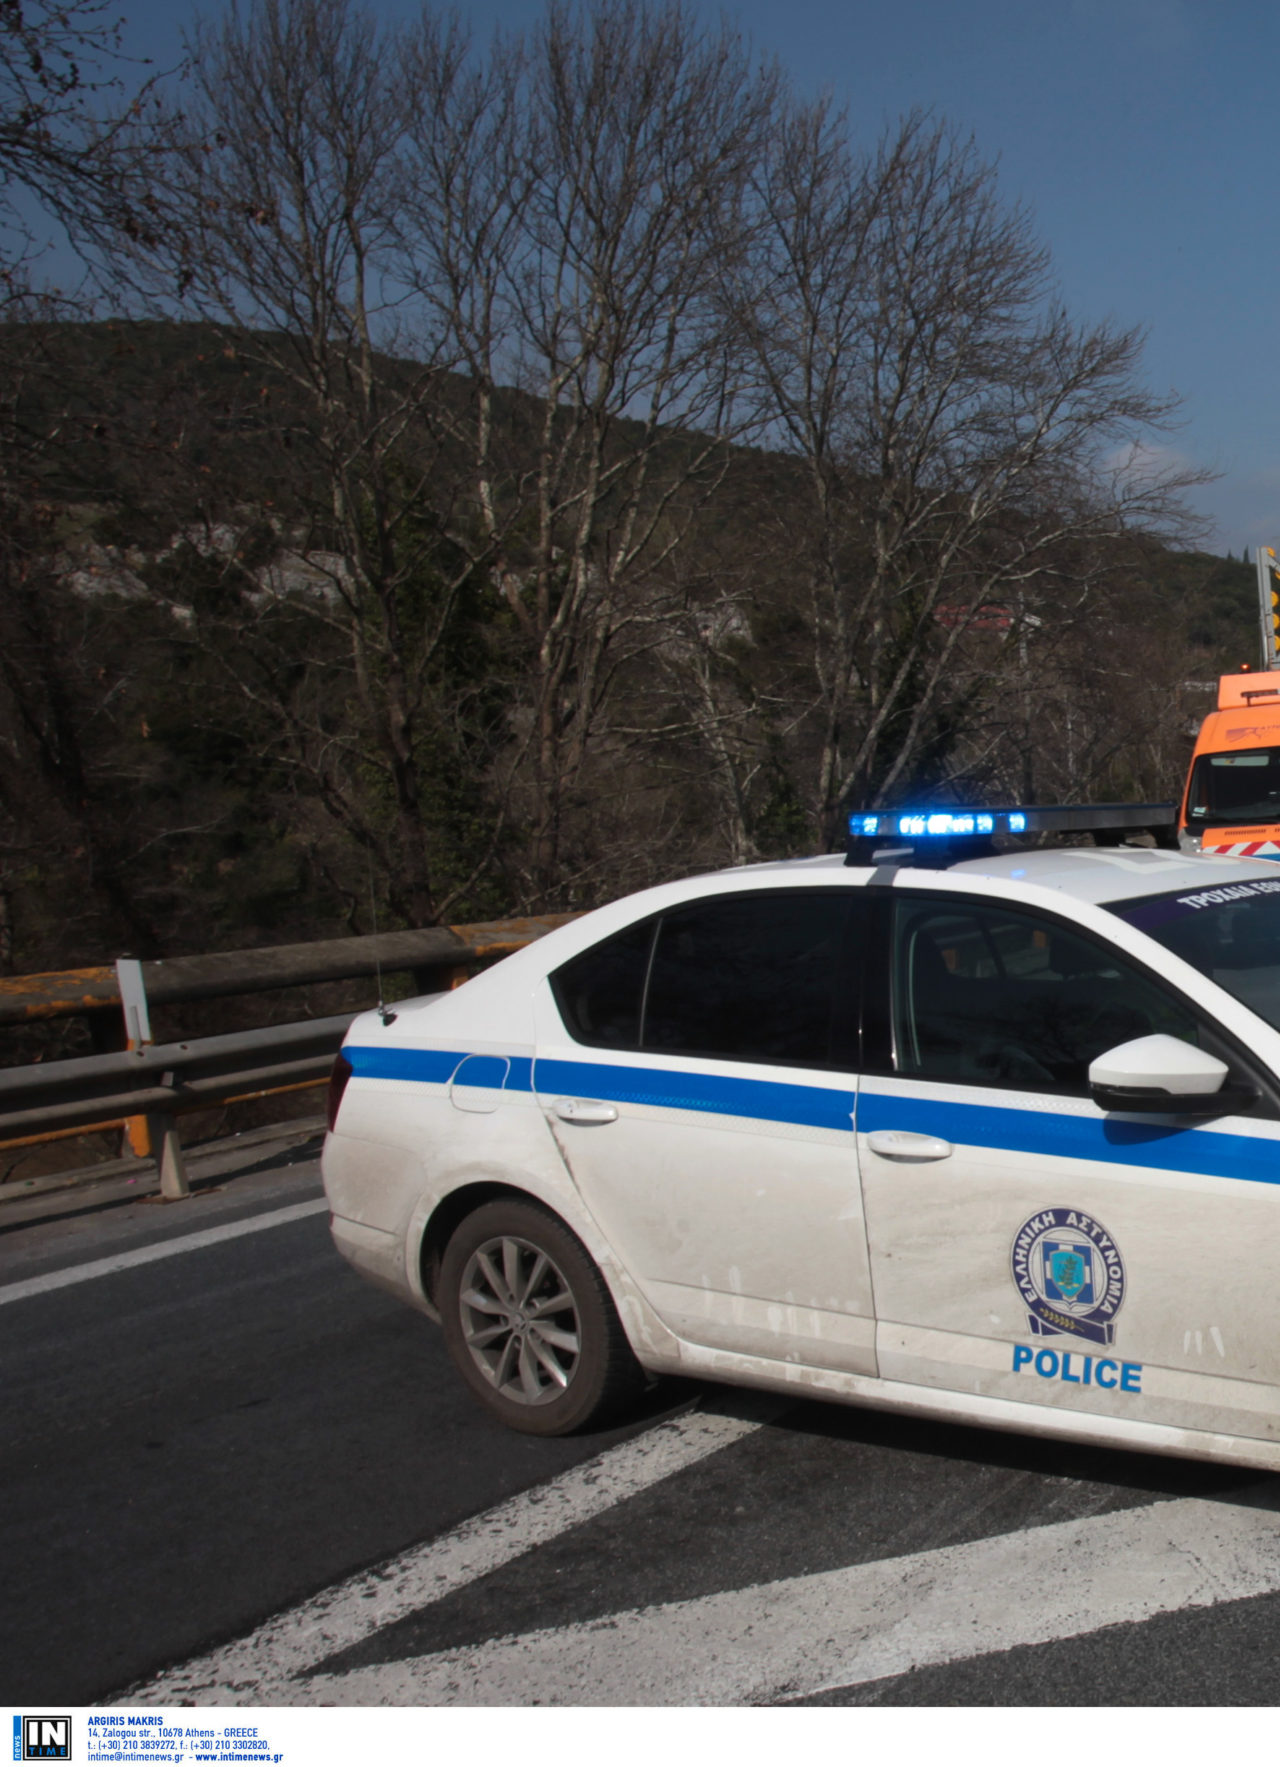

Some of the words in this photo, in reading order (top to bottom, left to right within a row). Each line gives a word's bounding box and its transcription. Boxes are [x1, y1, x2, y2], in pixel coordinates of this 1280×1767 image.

[1014, 1211, 1056, 1304] ΕΛΛΗΝΙΚΗ
[1065, 1211, 1122, 1315] ΑΣΤΥΝΟΜΙΑ
[1012, 1344, 1143, 1393] POLICE
